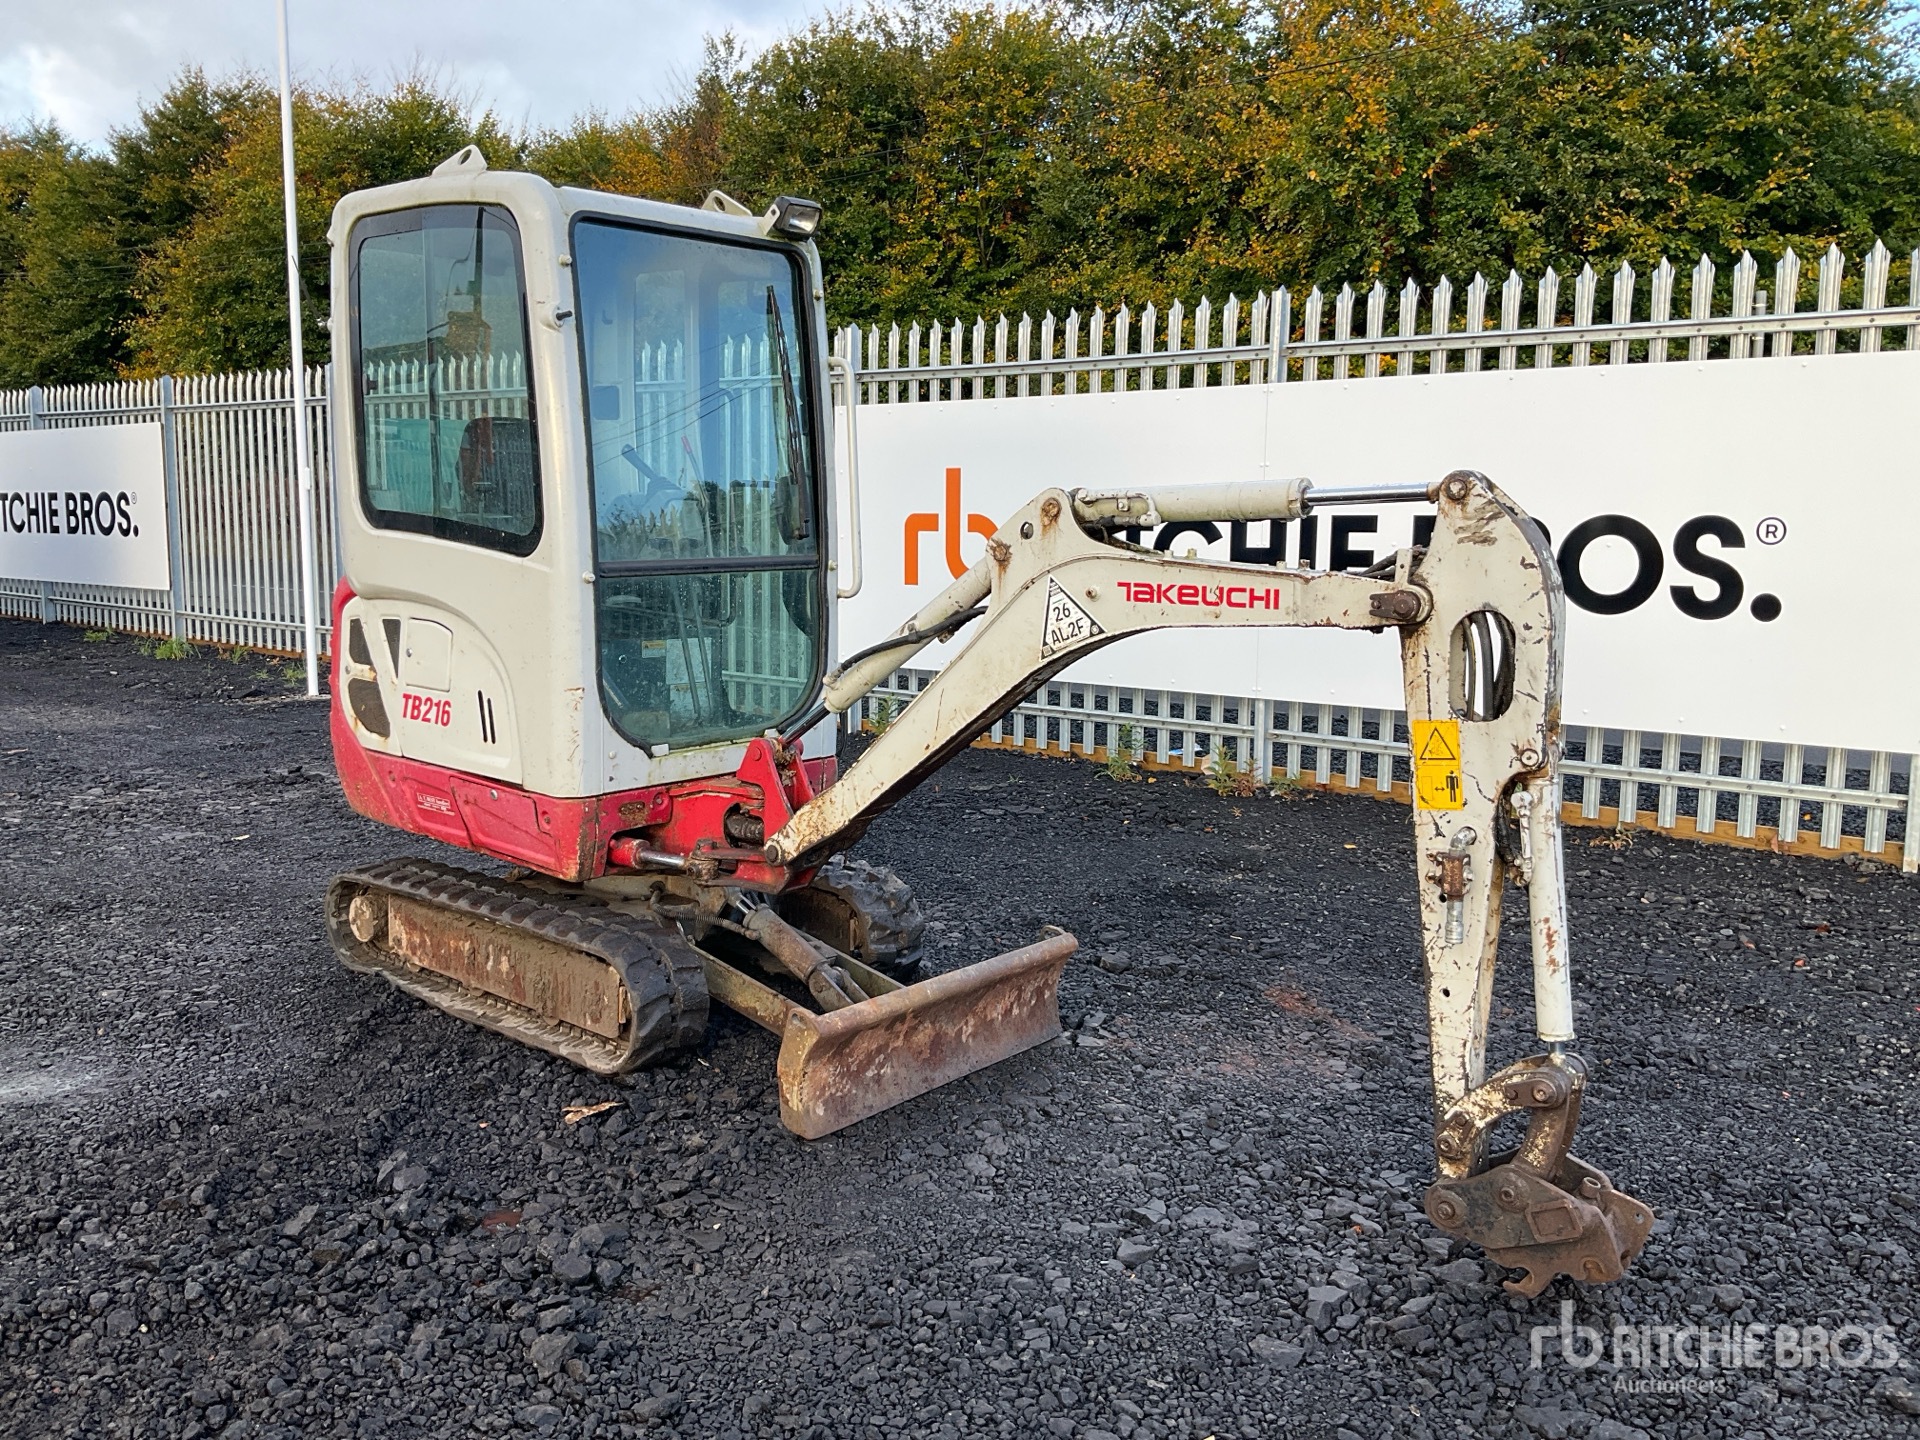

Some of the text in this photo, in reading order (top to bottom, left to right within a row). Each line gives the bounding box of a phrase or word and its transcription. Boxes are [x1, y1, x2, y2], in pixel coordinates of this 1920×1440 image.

[1053, 602, 1071, 622] 26
[1051, 617, 1084, 645] AL2F
[402, 693, 451, 727] TB216
